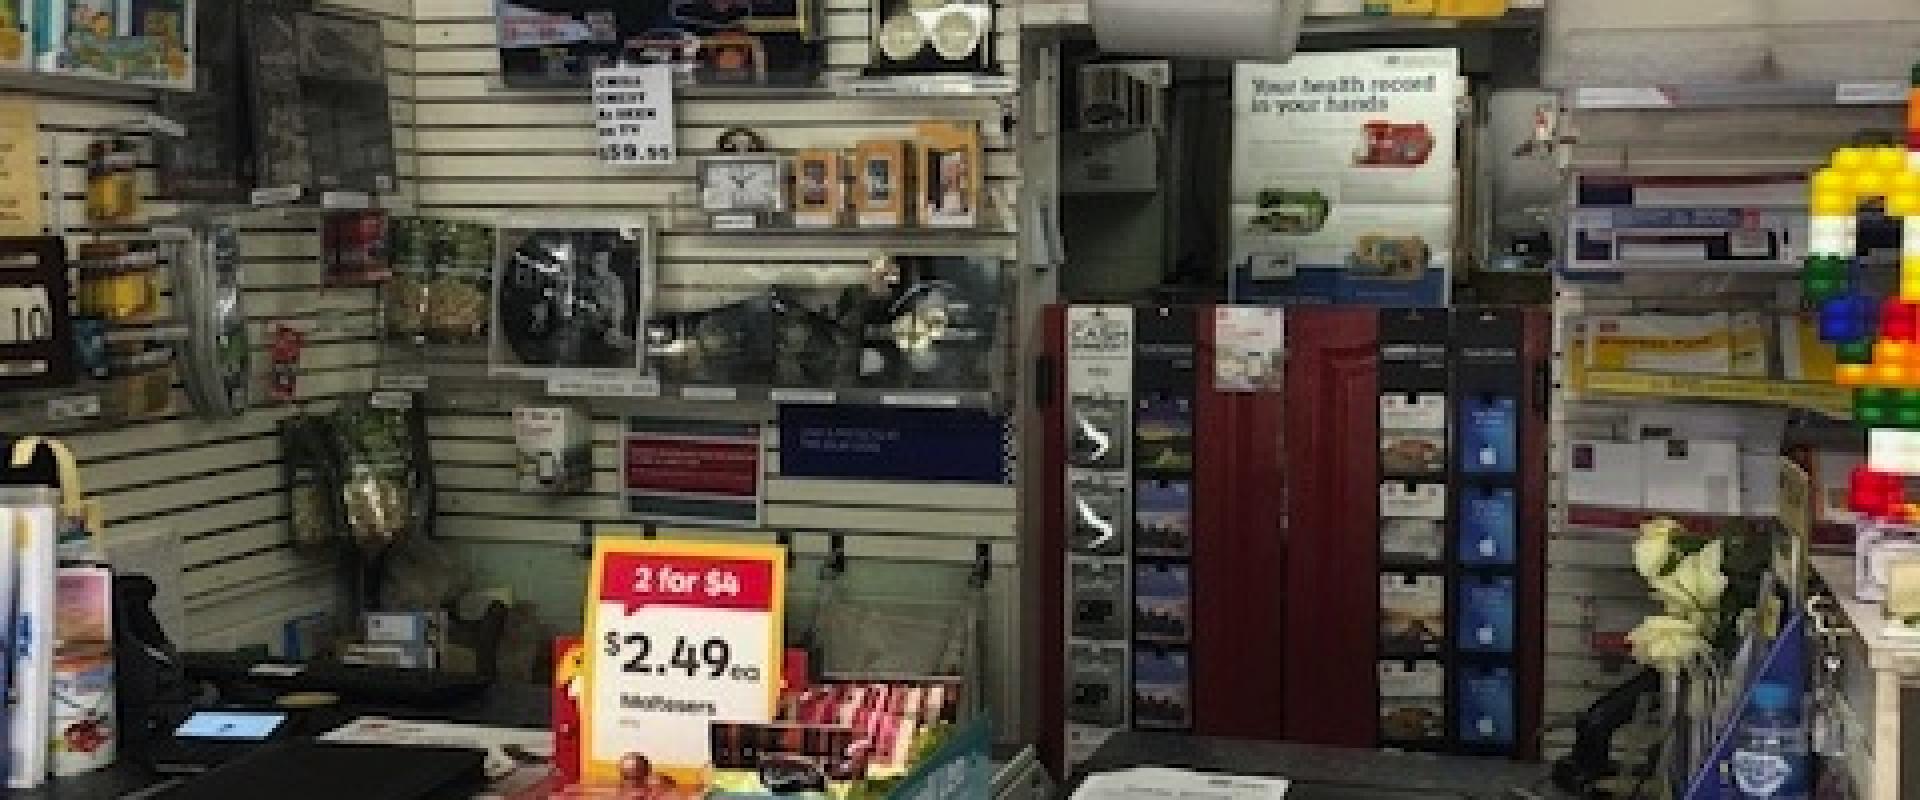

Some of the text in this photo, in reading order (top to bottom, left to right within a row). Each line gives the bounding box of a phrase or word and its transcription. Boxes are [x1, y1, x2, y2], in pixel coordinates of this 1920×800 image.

[1251, 74, 1436, 97] Your health record
[1275, 99, 1320, 117] your
[1326, 96, 1389, 113] hands
[12, 305, 51, 341] 10
[633, 566, 741, 597] 2 for $4
